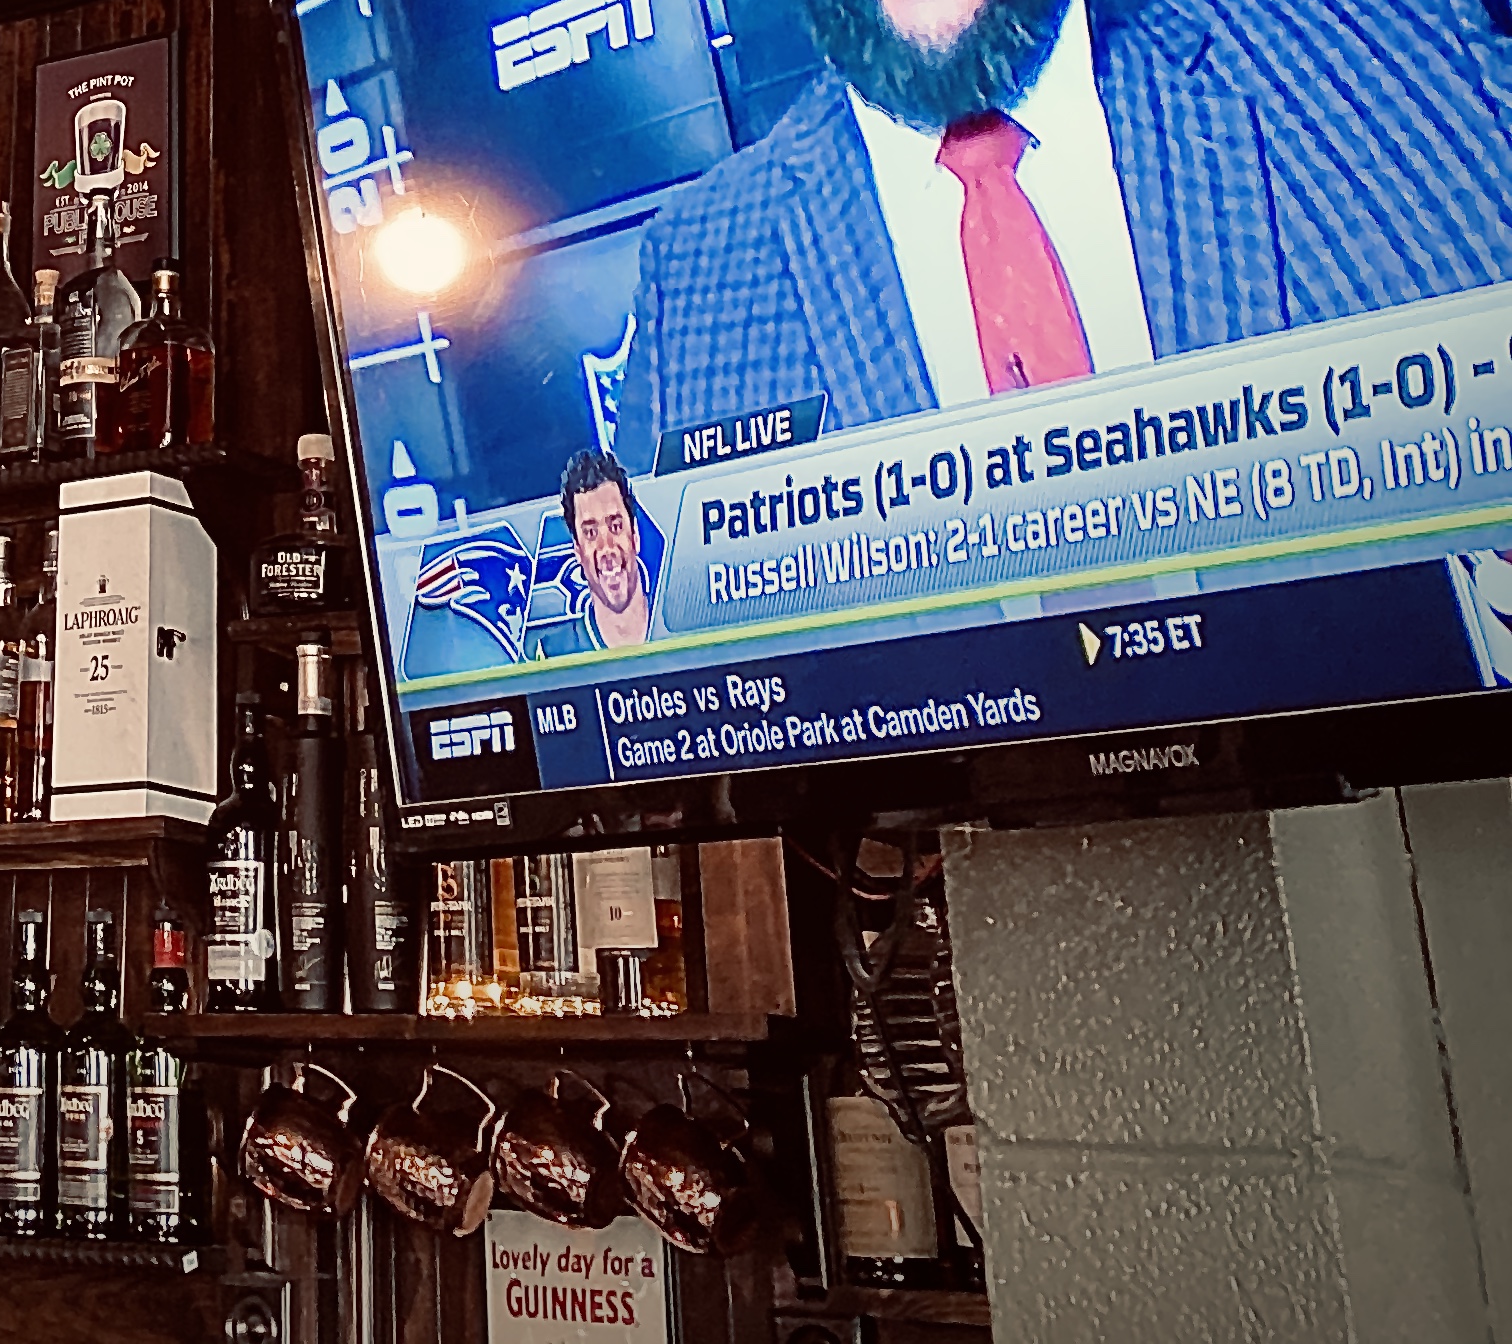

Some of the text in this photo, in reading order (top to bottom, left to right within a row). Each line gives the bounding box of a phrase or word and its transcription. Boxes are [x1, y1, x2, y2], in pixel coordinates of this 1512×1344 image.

[67, 74, 135, 99] THE PINT POT
[126, 180, 149, 194] 2014
[114, 194, 158, 224] OUSE
[683, 410, 793, 464] NFL LIVE
[701, 474, 864, 546] Patriots
[874, 443, 973, 522] (1-0)
[985, 434, 1036, 489] at
[1043, 384, 1309, 478] Seahawks
[1323, 343, 1456, 436] (1-0)
[707, 416, 1512, 604] Russell Wilson: 2-1 career vs NE (8 TD, Int) in
[261, 563, 322, 578] FORESTER
[277, 551, 302, 564] OLD
[64, 606, 139, 630] LAPHROAIG
[1103, 614, 1202, 659] 7:35 ET
[89, 654, 109, 681] 25
[608, 674, 786, 725] Orioles vs Rays
[429, 710, 516, 761] ESPN
[536, 703, 577, 735] MLB
[616, 688, 1042, 768] Game 2 at Oriole Park at Camden Yards
[1088, 743, 1200, 777] MAGNAVOX
[491, 1240, 655, 1280] Lovely day for a
[506, 1278, 635, 1325] GUINNESS
